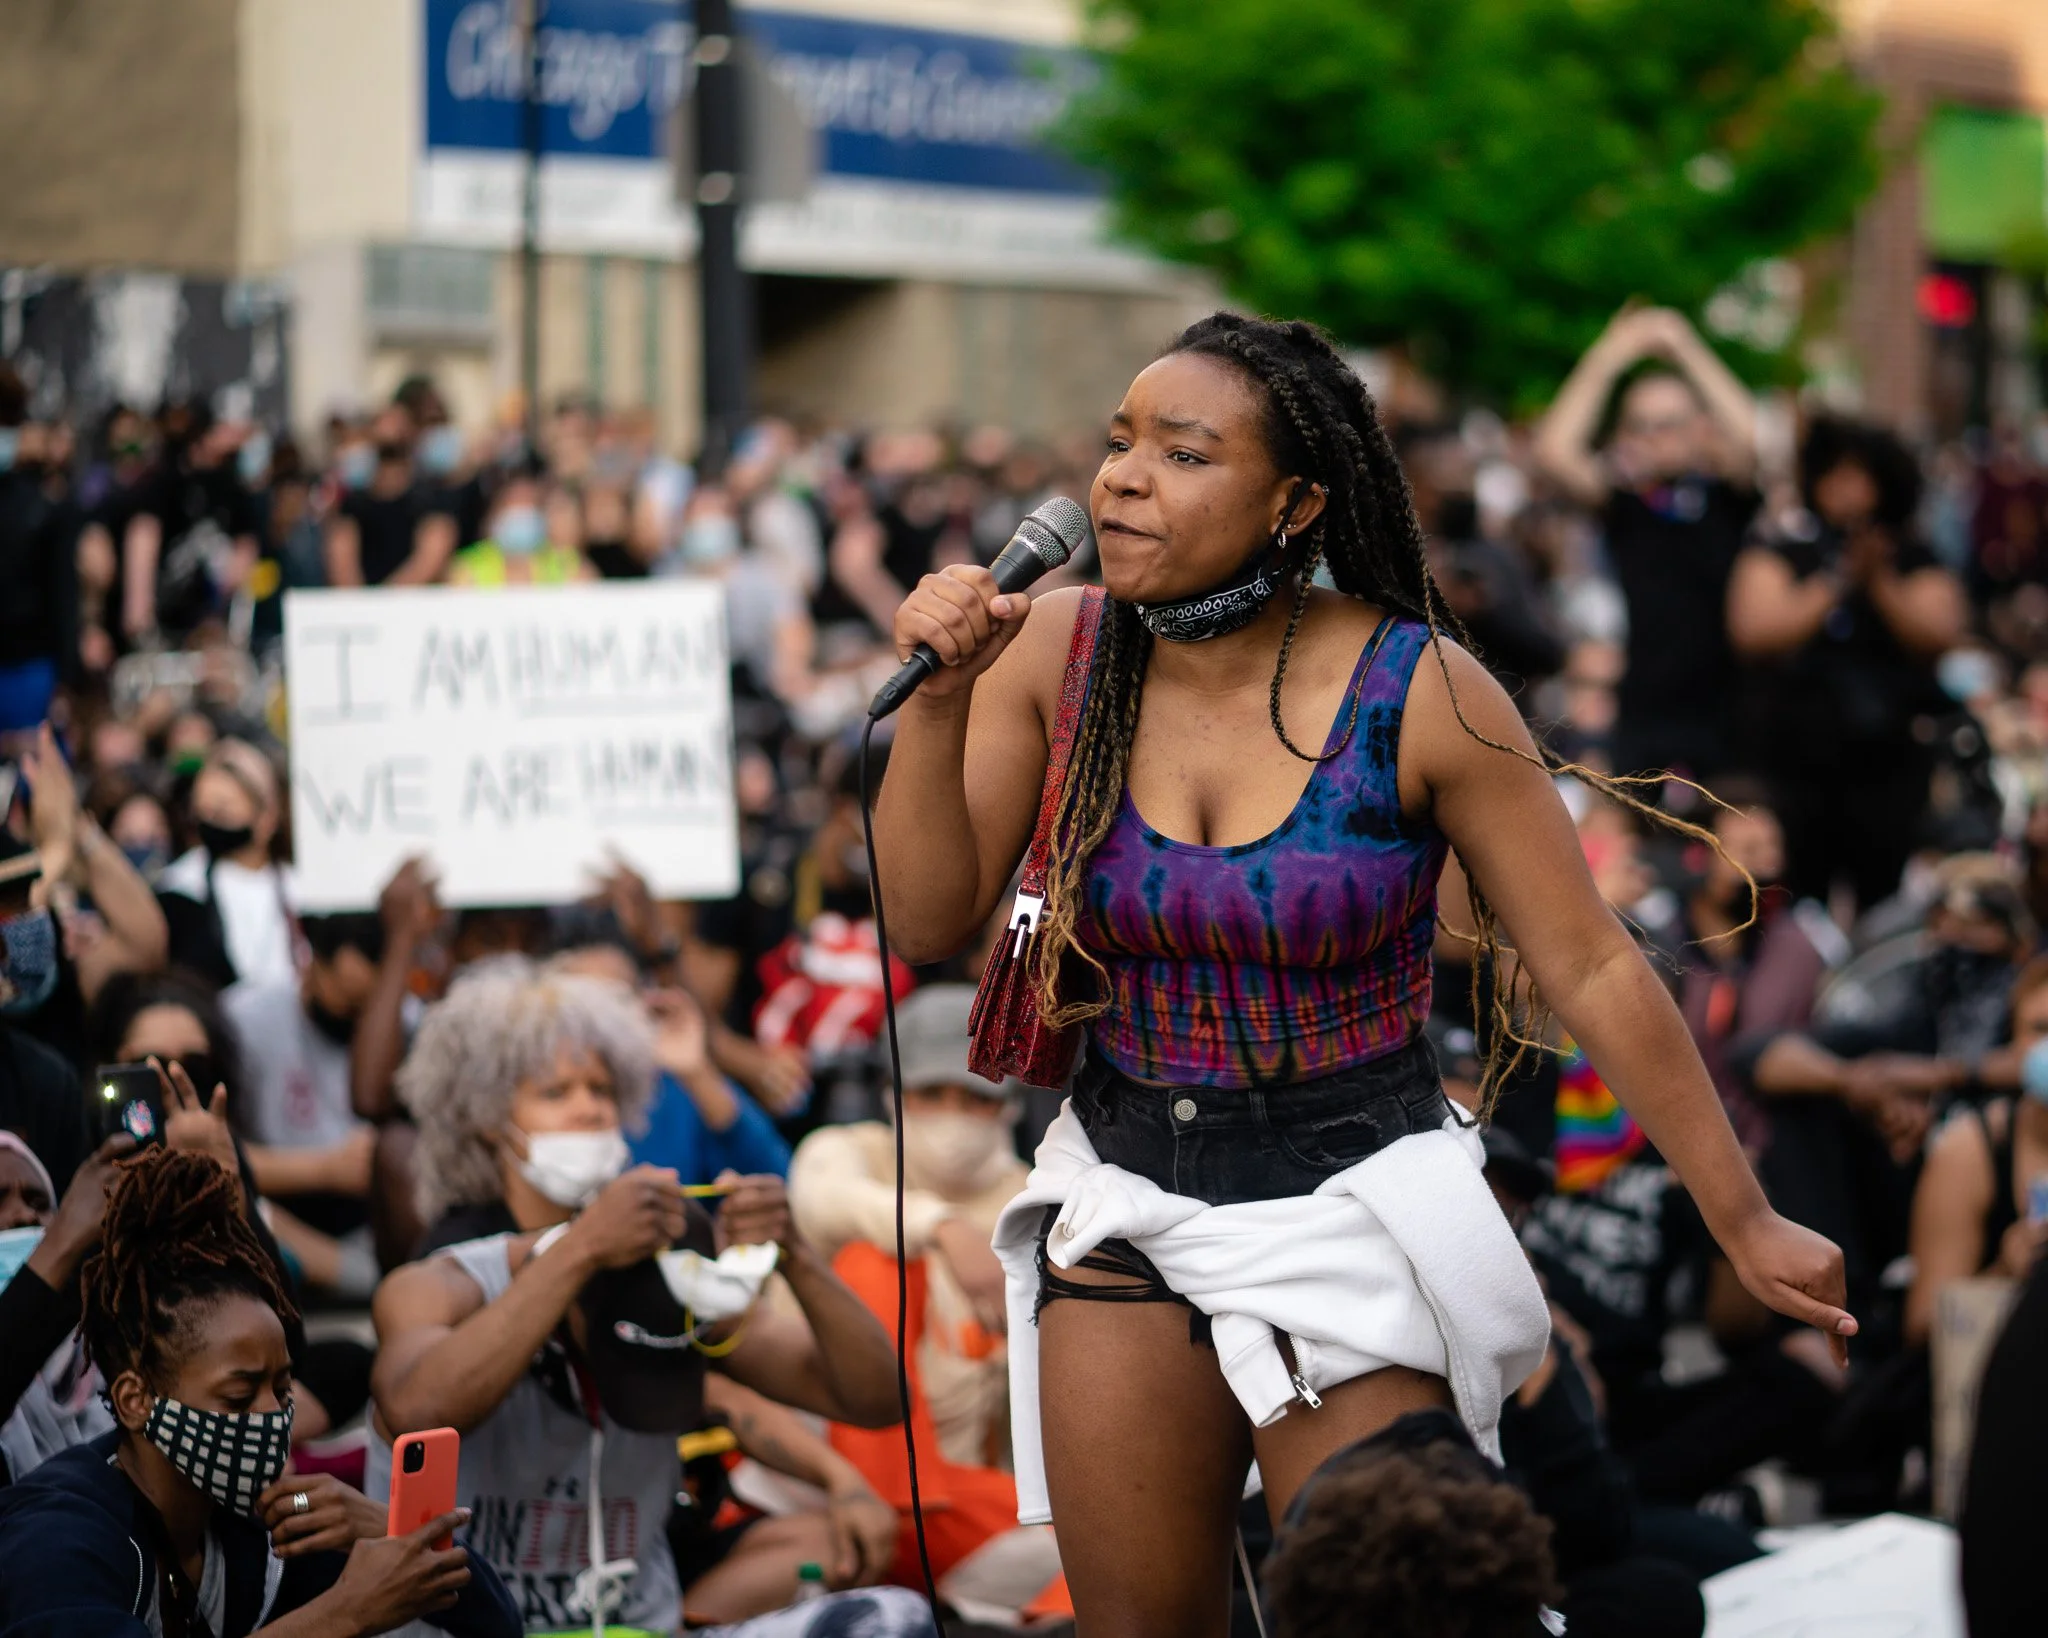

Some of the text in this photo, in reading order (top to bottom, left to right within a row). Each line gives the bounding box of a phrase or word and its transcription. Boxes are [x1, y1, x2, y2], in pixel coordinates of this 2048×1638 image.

[446, 0, 645, 141] Chcago
[302, 620, 723, 726] I AM HUMAN
[300, 752, 437, 836] WE
[458, 741, 569, 829] ARE
[465, 1494, 637, 1567] UNITD
